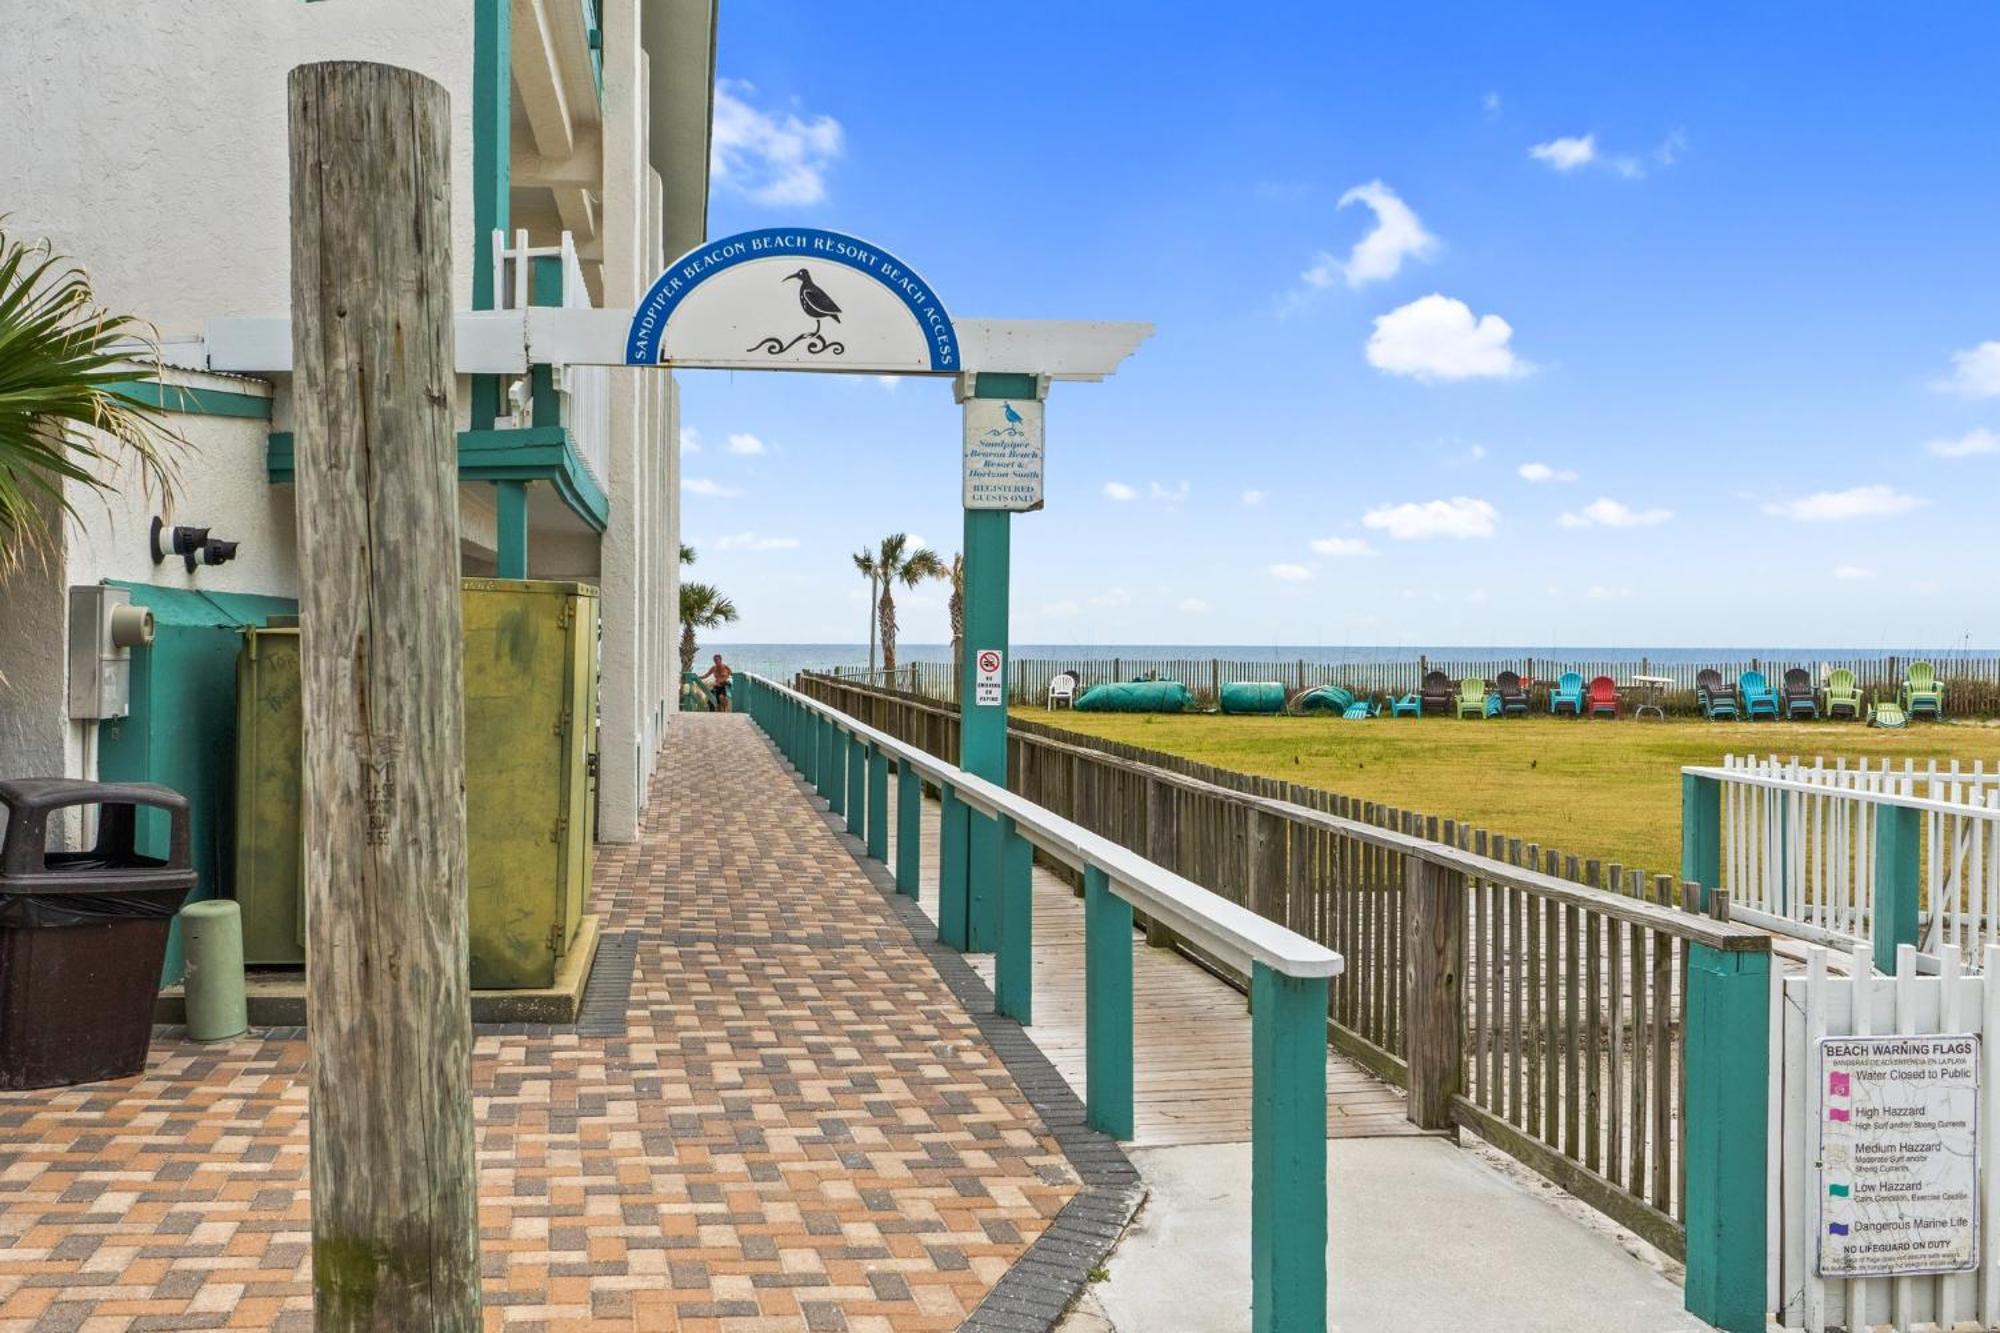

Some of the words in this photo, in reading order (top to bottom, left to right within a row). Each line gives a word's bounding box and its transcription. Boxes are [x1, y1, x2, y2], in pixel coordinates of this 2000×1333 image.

[635, 276, 683, 360] SANDPIPER
[682, 241, 746, 279] BEACON
[751, 235, 806, 251] BEACH
[814, 236, 879, 266] RESORT
[880, 262, 926, 304] BEACH
[923, 306, 952, 365] ACCESS
[978, 440, 1030, 449] Sandpiper
[970, 449, 1006, 458] Beacon
[1008, 450, 1038, 458] Beach
[983, 460, 1015, 468] Resort
[969, 470, 1009, 478] Horizon
[1826, 1046, 1869, 1057] BEACH
[1872, 1044, 1930, 1055] WARNING
[1932, 1043, 1972, 1054] FLAGS
[1856, 1070, 1886, 1081] Water
[1890, 1069, 1925, 1080] Closed
[1928, 1069, 1938, 1079] to
[1940, 1068, 1971, 1079] Public
[1855, 1107, 1880, 1119] High
[1883, 1106, 1925, 1117] Hazzard
[1855, 1143, 1897, 1154] Medium
[1899, 1142, 1942, 1153] Hazzard
[1855, 1182, 1876, 1192] Low
[1879, 1181, 1922, 1192] Hazzard
[1854, 1220, 1911, 1234] Dangerous
[1913, 1218, 1948, 1229] Marine
[1950, 1217, 1969, 1227] Life
[1843, 1245, 1856, 1254] NO
[1859, 1242, 1910, 1253] LIFEGUARD
[1912, 1241, 1926, 1250] ON
[1927, 1240, 1951, 1249] DUTY
